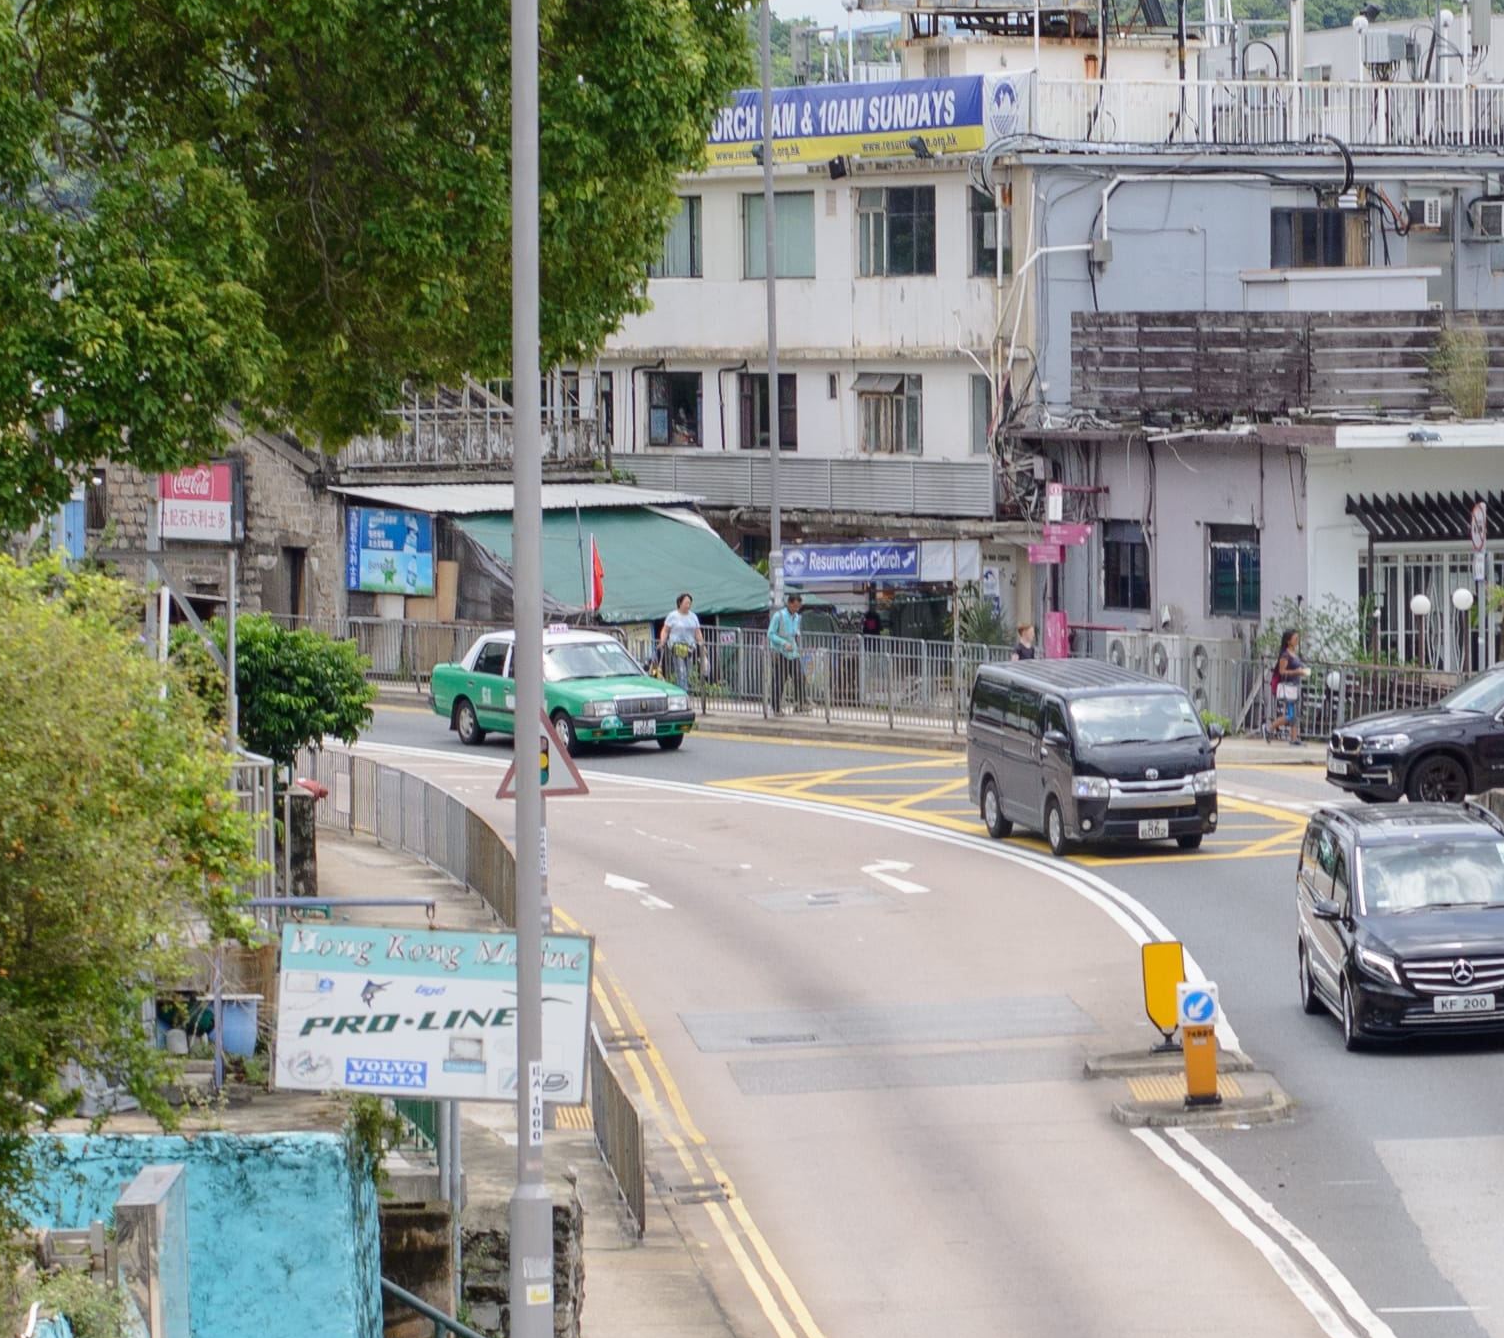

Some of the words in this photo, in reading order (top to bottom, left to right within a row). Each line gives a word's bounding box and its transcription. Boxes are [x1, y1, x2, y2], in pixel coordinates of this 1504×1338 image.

[800, 101, 813, 136] &
[818, 98, 864, 134] 10AM
[868, 89, 956, 132] SUNDAYS
[809, 550, 869, 571] Resurrection
[870, 551, 901, 570] Church
[289, 928, 375, 966] Hong
[387, 933, 463, 972] Kong
[473, 939, 585, 971] Maine
[1441, 999, 1458, 1010] KF
[1463, 997, 1488, 1009] 200
[350, 1060, 423, 1074] VOLVO
[348, 1072, 425, 1087] PENTA
